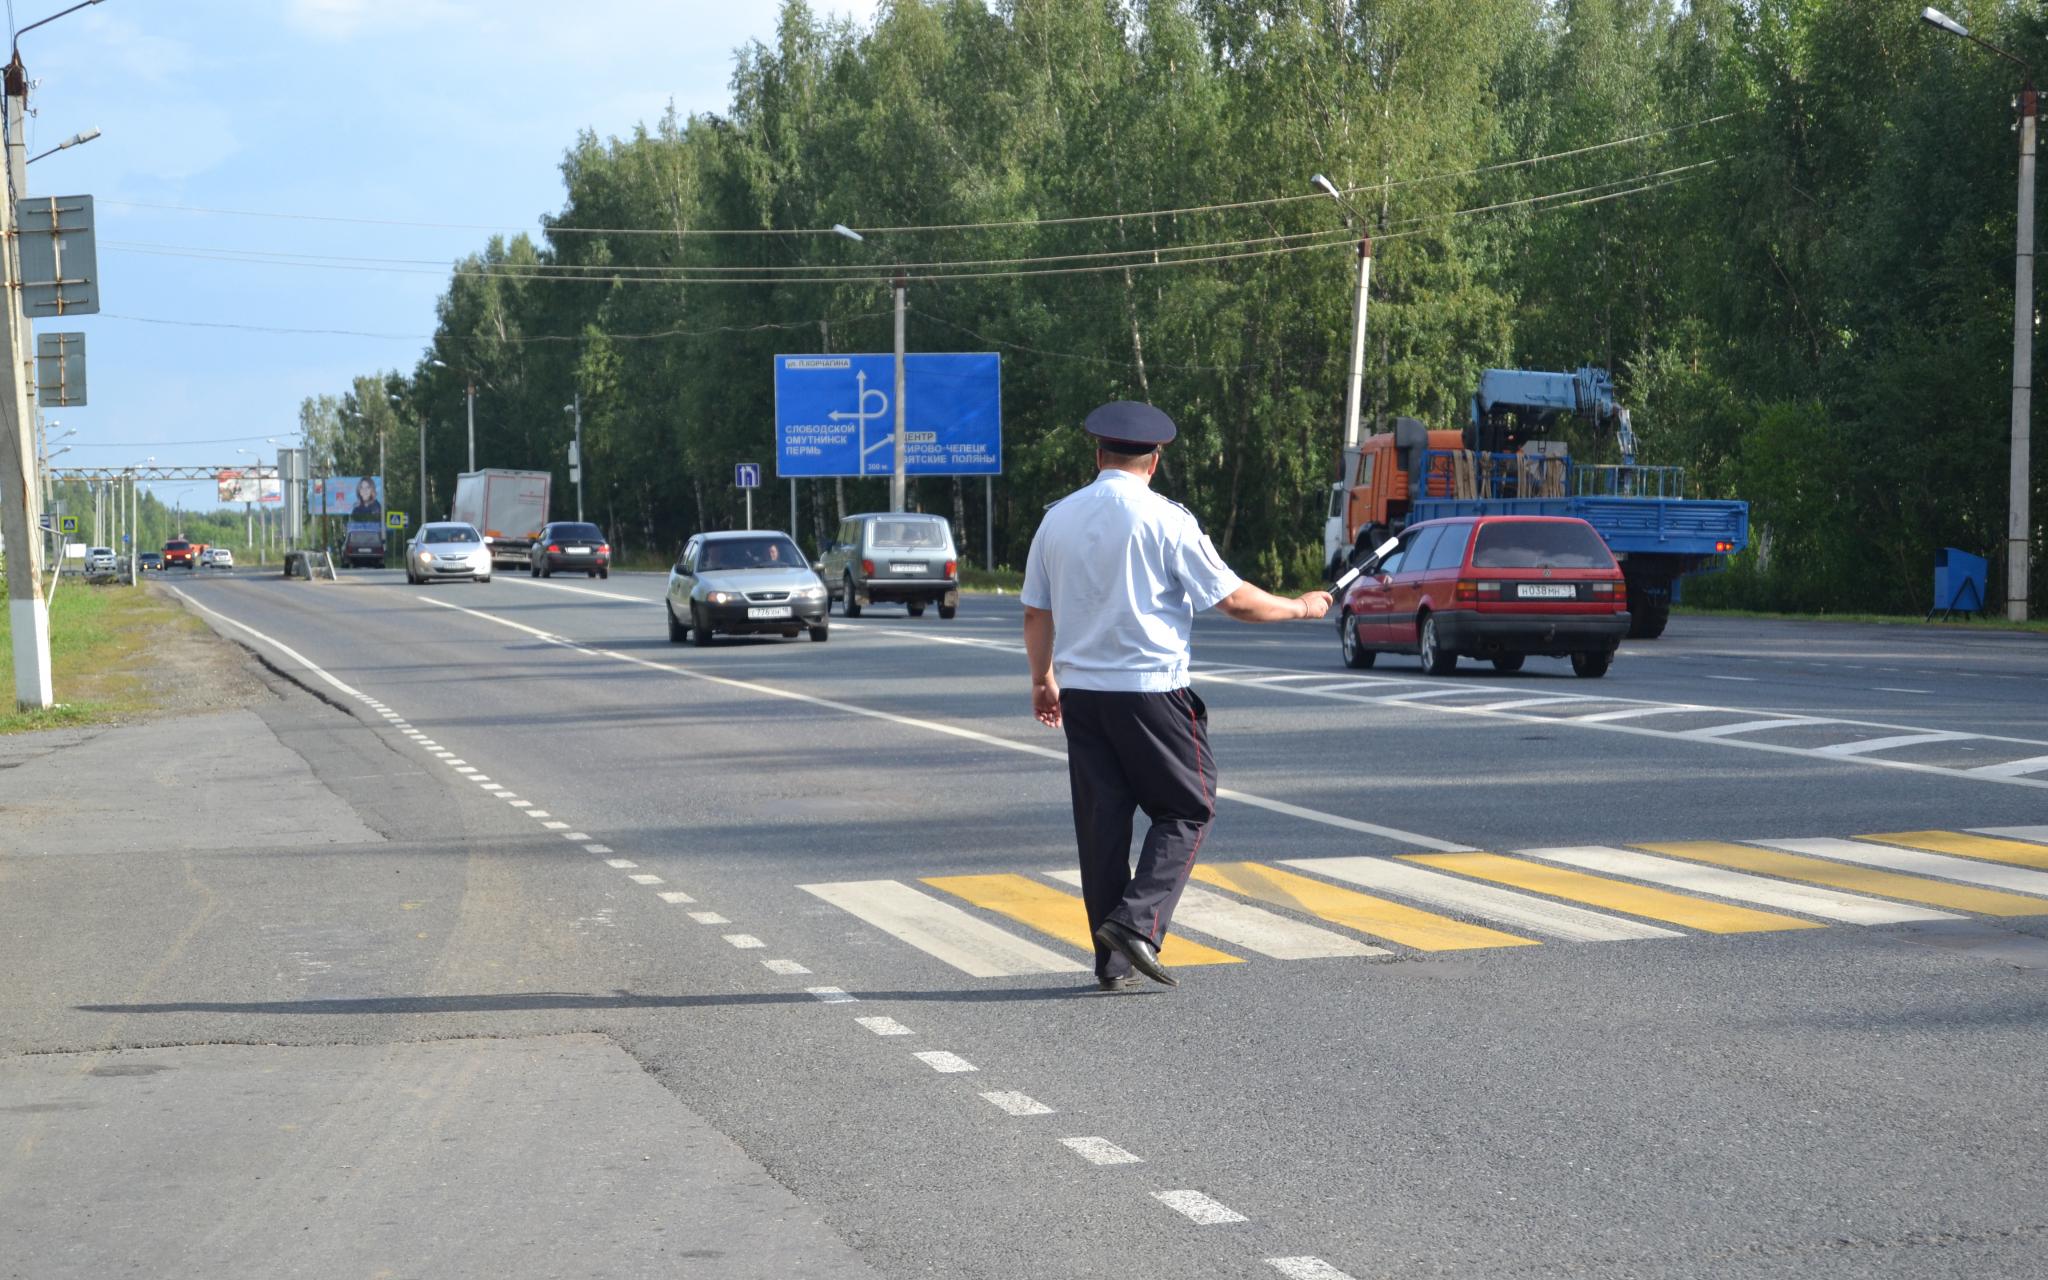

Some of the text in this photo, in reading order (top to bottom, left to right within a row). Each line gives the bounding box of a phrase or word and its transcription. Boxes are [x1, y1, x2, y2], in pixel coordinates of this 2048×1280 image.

[785, 422, 855, 434] СЛОБОДСКОЙ
[785, 435, 847, 444] ОМУТНИНСК
[785, 446, 821, 456] ПЕРМЬ
[952, 454, 995, 464] ПОЛЯНЫ
